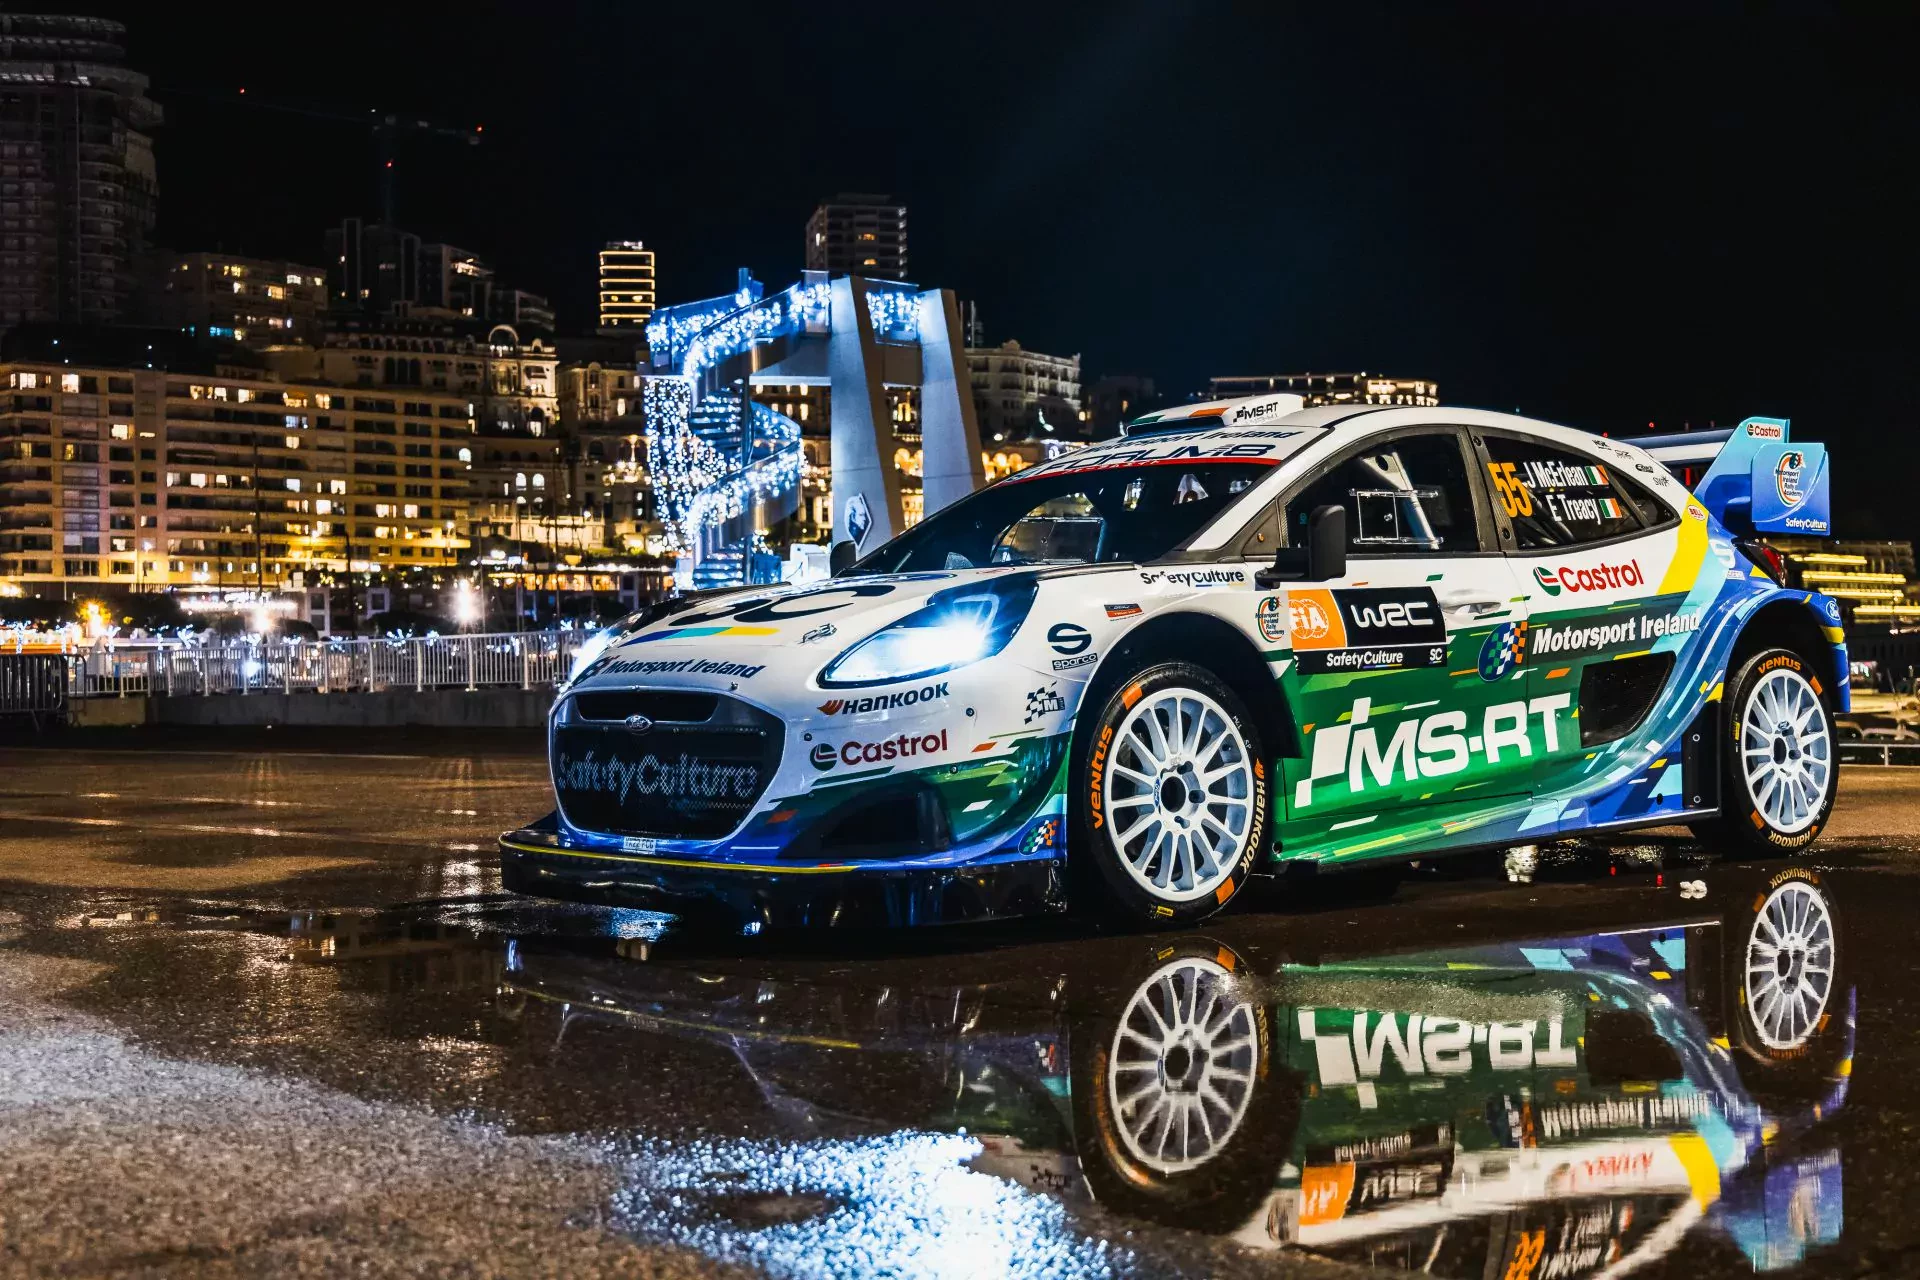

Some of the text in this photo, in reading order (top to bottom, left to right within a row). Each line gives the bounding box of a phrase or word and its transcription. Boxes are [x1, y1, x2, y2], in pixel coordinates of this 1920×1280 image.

[1244, 402, 1279, 420] MS-RT
[1754, 425, 1781, 437] Castrol
[1522, 461, 1590, 489] J McErlean
[1487, 462, 1533, 518] 55
[1546, 493, 1602, 525] E Treacy
[1785, 517, 1828, 531] SafetyCulture
[1558, 558, 1645, 593] Castrol
[1255, 611, 1280, 619] Motorsport
[1350, 601, 1434, 629] WRC
[1265, 624, 1277, 632] Rally
[1532, 606, 1701, 655] Motorsport Ireland
[604, 658, 766, 679] Motorsport Ireland
[1053, 655, 1098, 669] sparco
[1326, 648, 1444, 669] SafetyCulture SC
[840, 728, 948, 767] Castrol
[1347, 692, 1571, 794] MS-RT
